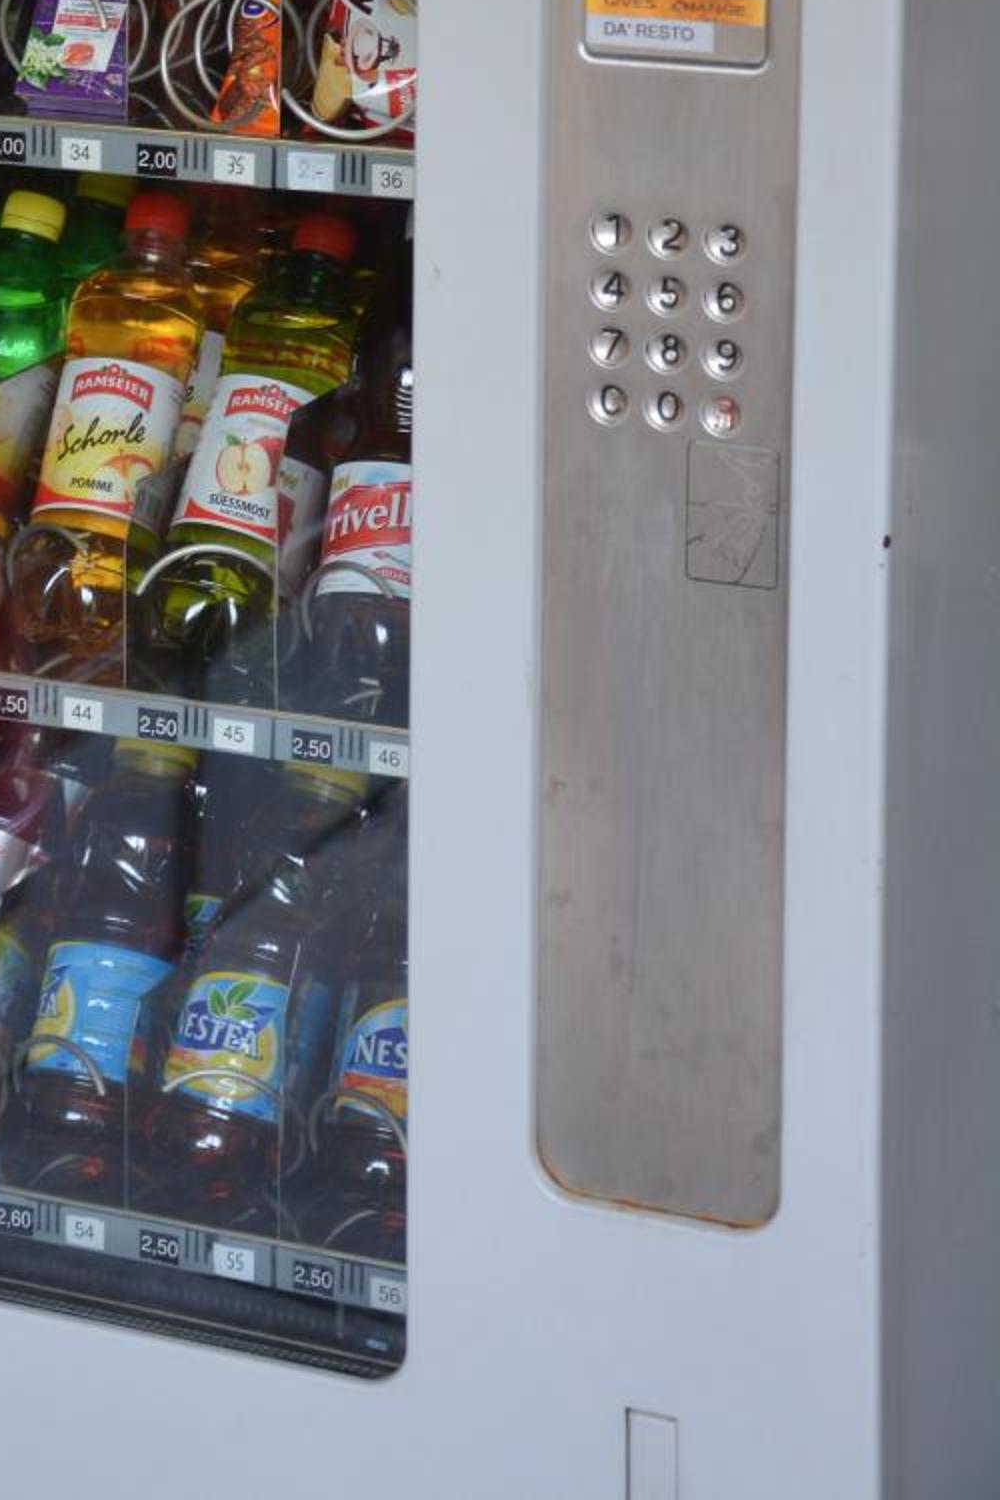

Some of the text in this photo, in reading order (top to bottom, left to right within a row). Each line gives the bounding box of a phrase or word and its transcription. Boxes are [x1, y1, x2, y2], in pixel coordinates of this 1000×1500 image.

[603, 21, 695, 42] DA' RESTO
[69, 143, 91, 161] 34
[138, 150, 177, 171] 2,00
[380, 171, 403, 189] 36
[607, 212, 739, 257] 1 2 3
[603, 271, 738, 313] 4 5 6
[603, 327, 737, 371] 7 8 9
[74, 374, 150, 403] RAMSEIER
[231, 393, 293, 415] RAMSEI
[657, 390, 680, 422] 0
[58, 411, 147, 460] Schorle
[71, 476, 114, 493] POMME
[208, 493, 271, 519] SUESSMOST
[329, 489, 412, 541] rivell
[71, 703, 92, 721] 44
[140, 717, 177, 738] 2,50
[223, 726, 245, 743] 45
[293, 737, 331, 759] 2,50
[379, 749, 401, 767] 46
[177, 1011, 260, 1060] ESTEA
[355, 1033, 407, 1070] NES
